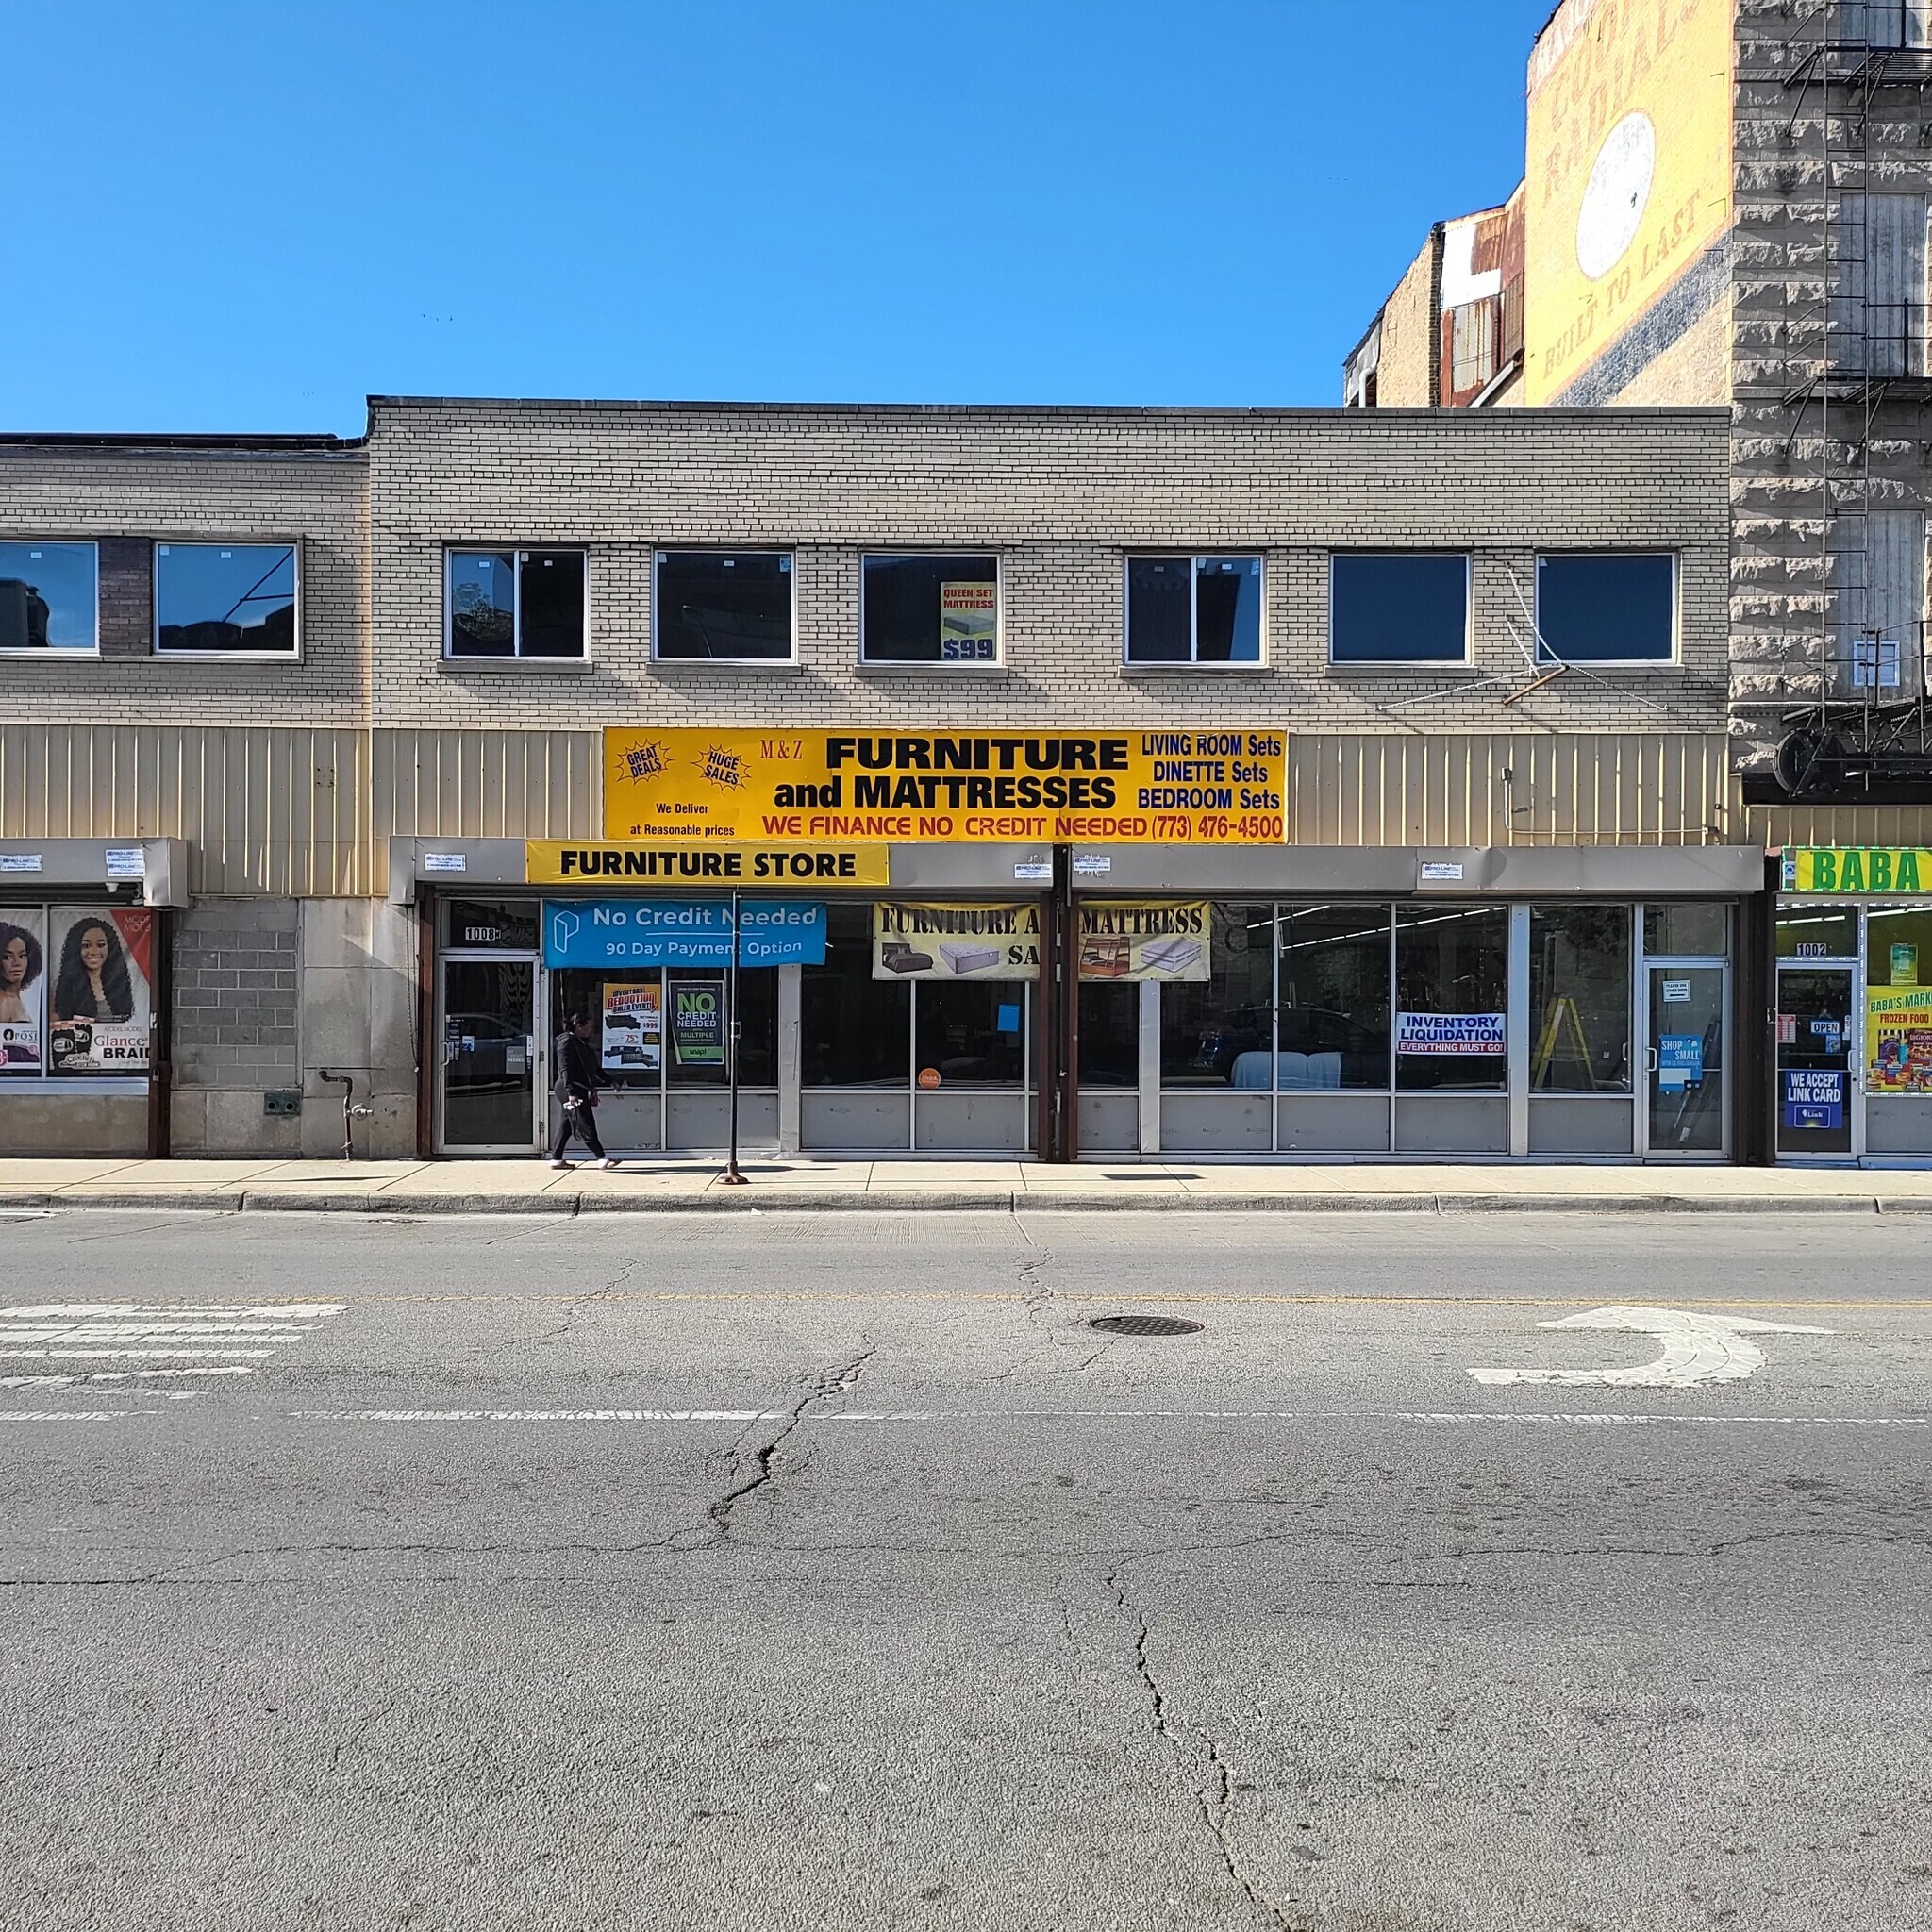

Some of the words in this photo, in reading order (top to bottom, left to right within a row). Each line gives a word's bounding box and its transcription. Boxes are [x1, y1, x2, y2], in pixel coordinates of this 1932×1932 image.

[1543, 299, 1598, 379] BUILT
[1607, 266, 1632, 318] TO
[1641, 189, 1701, 283] LAST
[943, 589, 974, 598] QUEEN
[976, 589, 993, 597] SET
[943, 600, 994, 608] MATTRESS
[943, 638, 993, 659] $99
[626, 745, 658, 765] GREAT
[760, 740, 774, 759] M
[777, 740, 790, 759] &
[790, 740, 803, 759] Z
[826, 738, 1128, 770] FURNITURE
[1142, 735, 1191, 756] LIVING
[1196, 735, 1242, 756] ROOM
[1248, 735, 1281, 757] Sets
[630, 758, 661, 777] DEALS
[708, 751, 739, 770] HUGE
[705, 764, 739, 785] SALES
[1153, 761, 1224, 782] DINETTE
[1231, 761, 1268, 782] Sets
[774, 776, 841, 808] and
[854, 776, 1116, 808] MATTRESSES
[1139, 789, 1232, 808] BEDROOM
[1239, 789, 1280, 809] Sets
[656, 803, 672, 814] We
[675, 803, 709, 814] Deliver
[630, 824, 641, 835] at
[644, 824, 701, 835] Reasonable
[705, 824, 735, 837] prices
[762, 816, 802, 835] WE
[809, 816, 911, 835] FINANCE
[919, 817, 953, 836] NO
[965, 817, 1047, 837] CREDIT
[1055, 817, 1147, 837] NEEDED
[1152, 816, 1192, 840] (773)
[1198, 816, 1283, 839] 476-4500
[560, 851, 742, 877] FURNITURE
[754, 853, 856, 877] STORE
[593, 908, 627, 925] No
[635, 907, 712, 925] Credit
[722, 907, 817, 925] Needed
[881, 908, 1017, 935] FURNITURE
[1081, 908, 1203, 935] MATTRESS
[467, 928, 494, 941] 1008
[606, 943, 626, 955] 90
[631, 942, 662, 956] Day
[747, 941, 802, 957] Option
[1008, 945, 1041, 965] SA
[1798, 943, 1826, 956] 1002
[677, 993, 716, 1012] NO
[1870, 996, 1902, 1012] BABA'S
[1905, 991, 1932, 1008] MARK
[1406, 1016, 1500, 1028] INVENTORY
[1813, 1023, 1838, 1032] OPEN
[1880, 1014, 1907, 1024] FROZEN
[1910, 1013, 1929, 1024] FOOD
[94, 1035, 145, 1046] Glance
[1400, 1028, 1503, 1041] LIQUIDATION
[1400, 1042, 1458, 1052] EVERYTHING
[1459, 1043, 1485, 1052] MUST
[1487, 1043, 1503, 1052] GO!
[1661, 1040, 1683, 1050] SHOP
[1674, 1050, 1700, 1060] SMALL
[1790, 1073, 1805, 1087] WE
[1806, 1073, 1839, 1088] ACCEPT
[1788, 1088, 1811, 1102] LINK
[1812, 1088, 1840, 1103] CARD
